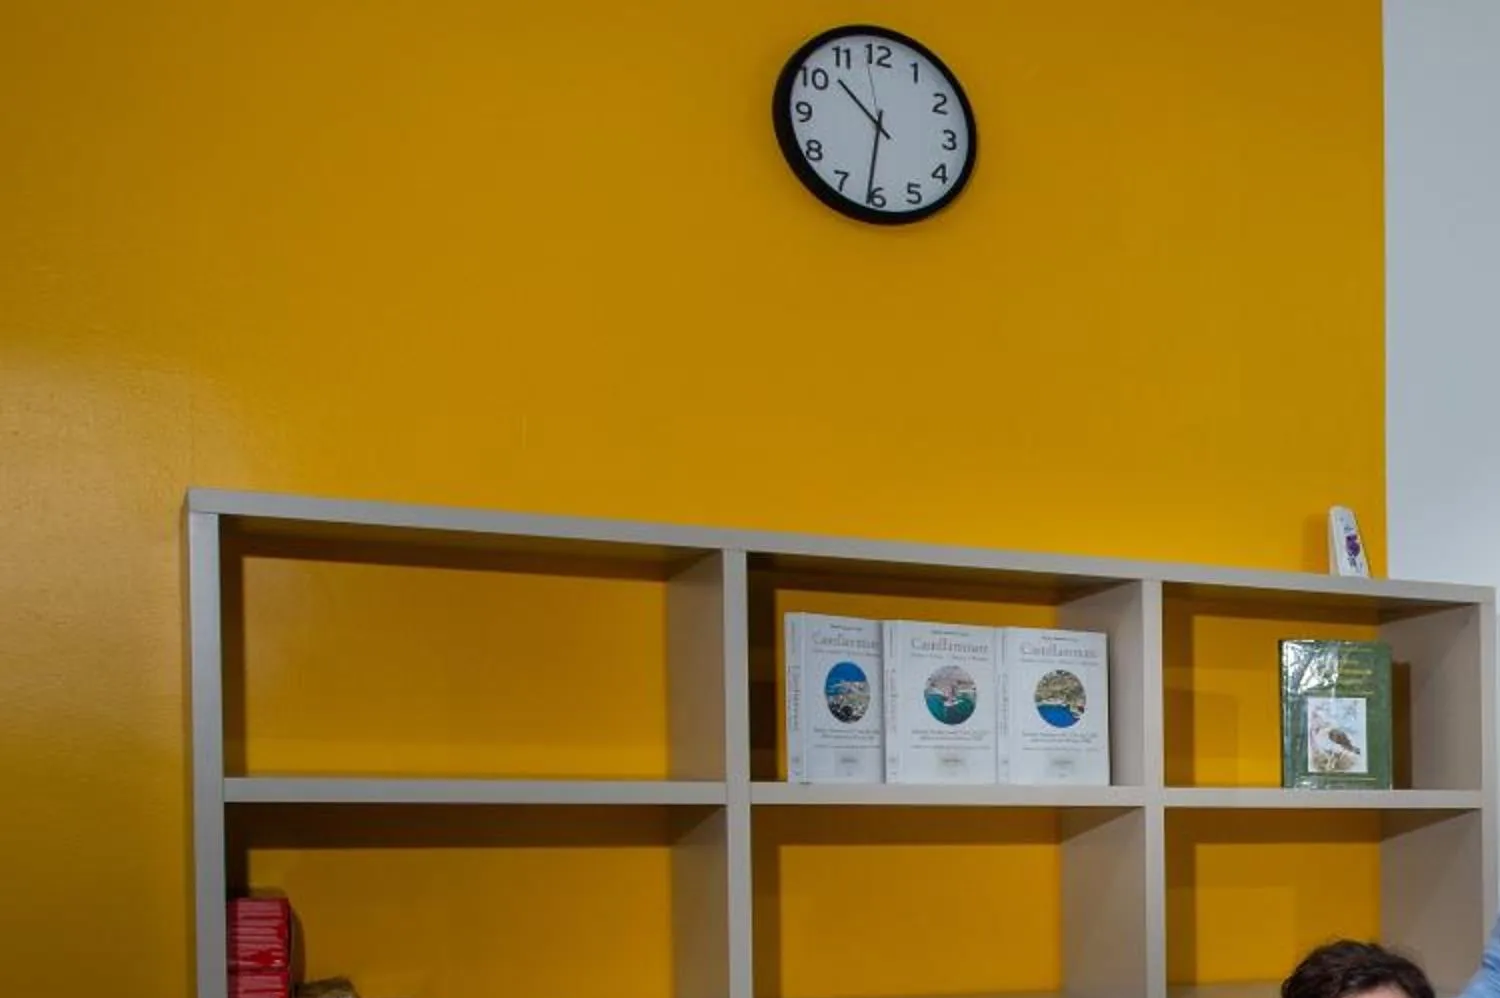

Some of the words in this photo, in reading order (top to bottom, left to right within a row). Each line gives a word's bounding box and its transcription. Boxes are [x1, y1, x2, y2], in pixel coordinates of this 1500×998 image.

[832, 45, 851, 69] 11
[865, 43, 893, 68] 12
[801, 66, 829, 90] 10
[910, 62, 919, 84] 1
[795, 101, 813, 122] 9
[932, 92, 948, 115] 2
[805, 139, 823, 161] 8
[941, 129, 957, 151] 3
[833, 169, 849, 192] 7
[931, 163, 948, 185] 4
[869, 187, 887, 208] 6
[906, 182, 923, 205] 5
